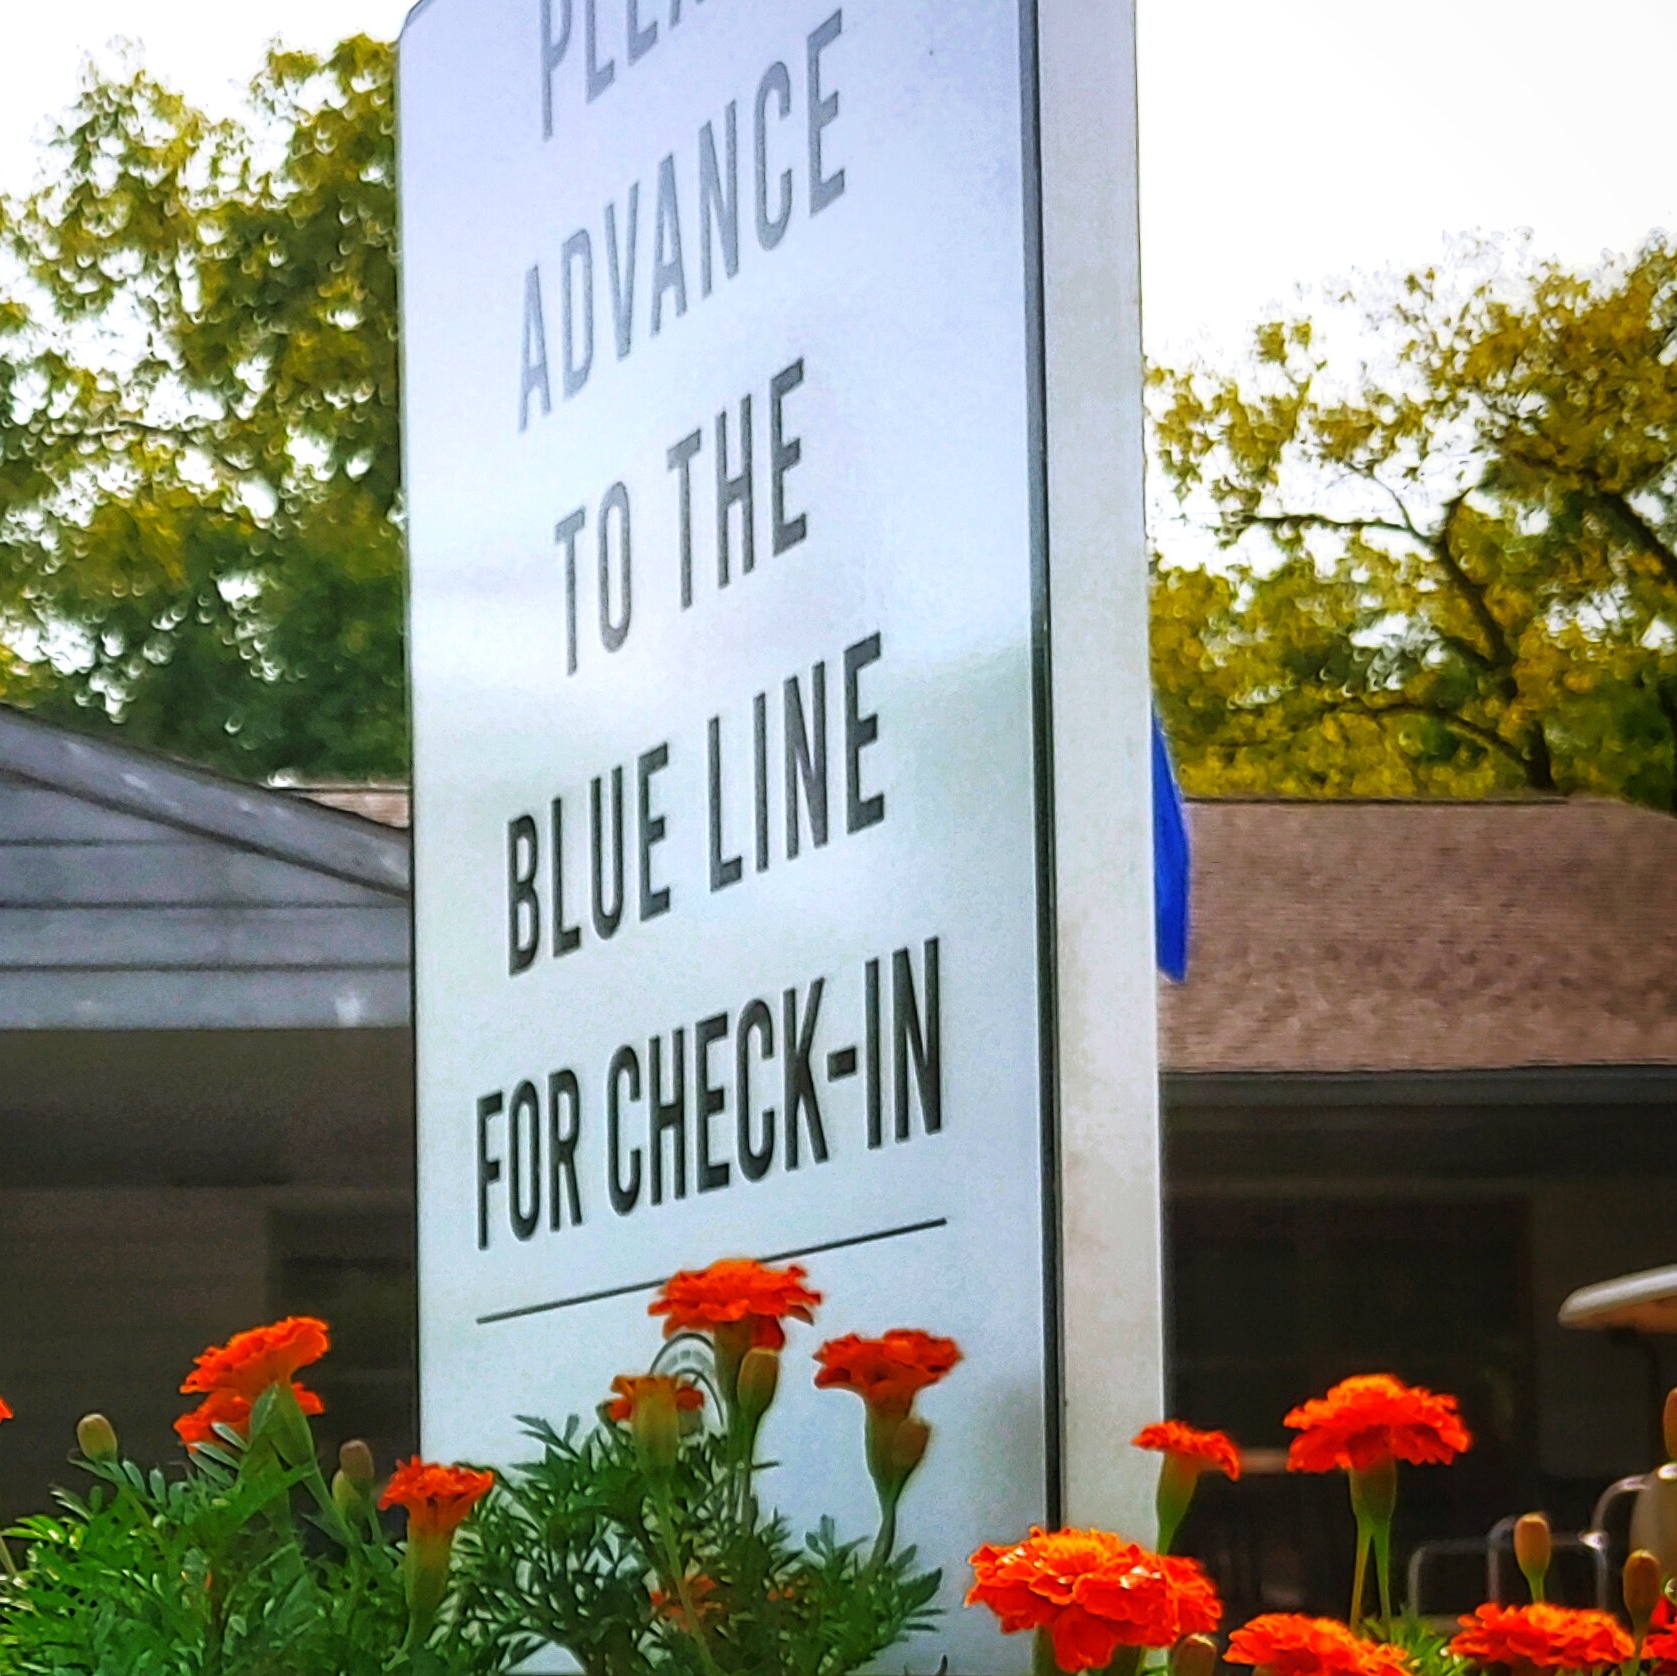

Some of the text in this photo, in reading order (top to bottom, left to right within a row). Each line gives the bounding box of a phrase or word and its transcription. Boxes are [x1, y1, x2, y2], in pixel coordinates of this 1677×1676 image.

[519, 7, 846, 434] ADVANCE
[554, 356, 807, 676] TO THE
[508, 631, 885, 978] BLUE LINE
[476, 935, 943, 1251] FOR CHECK-IN
